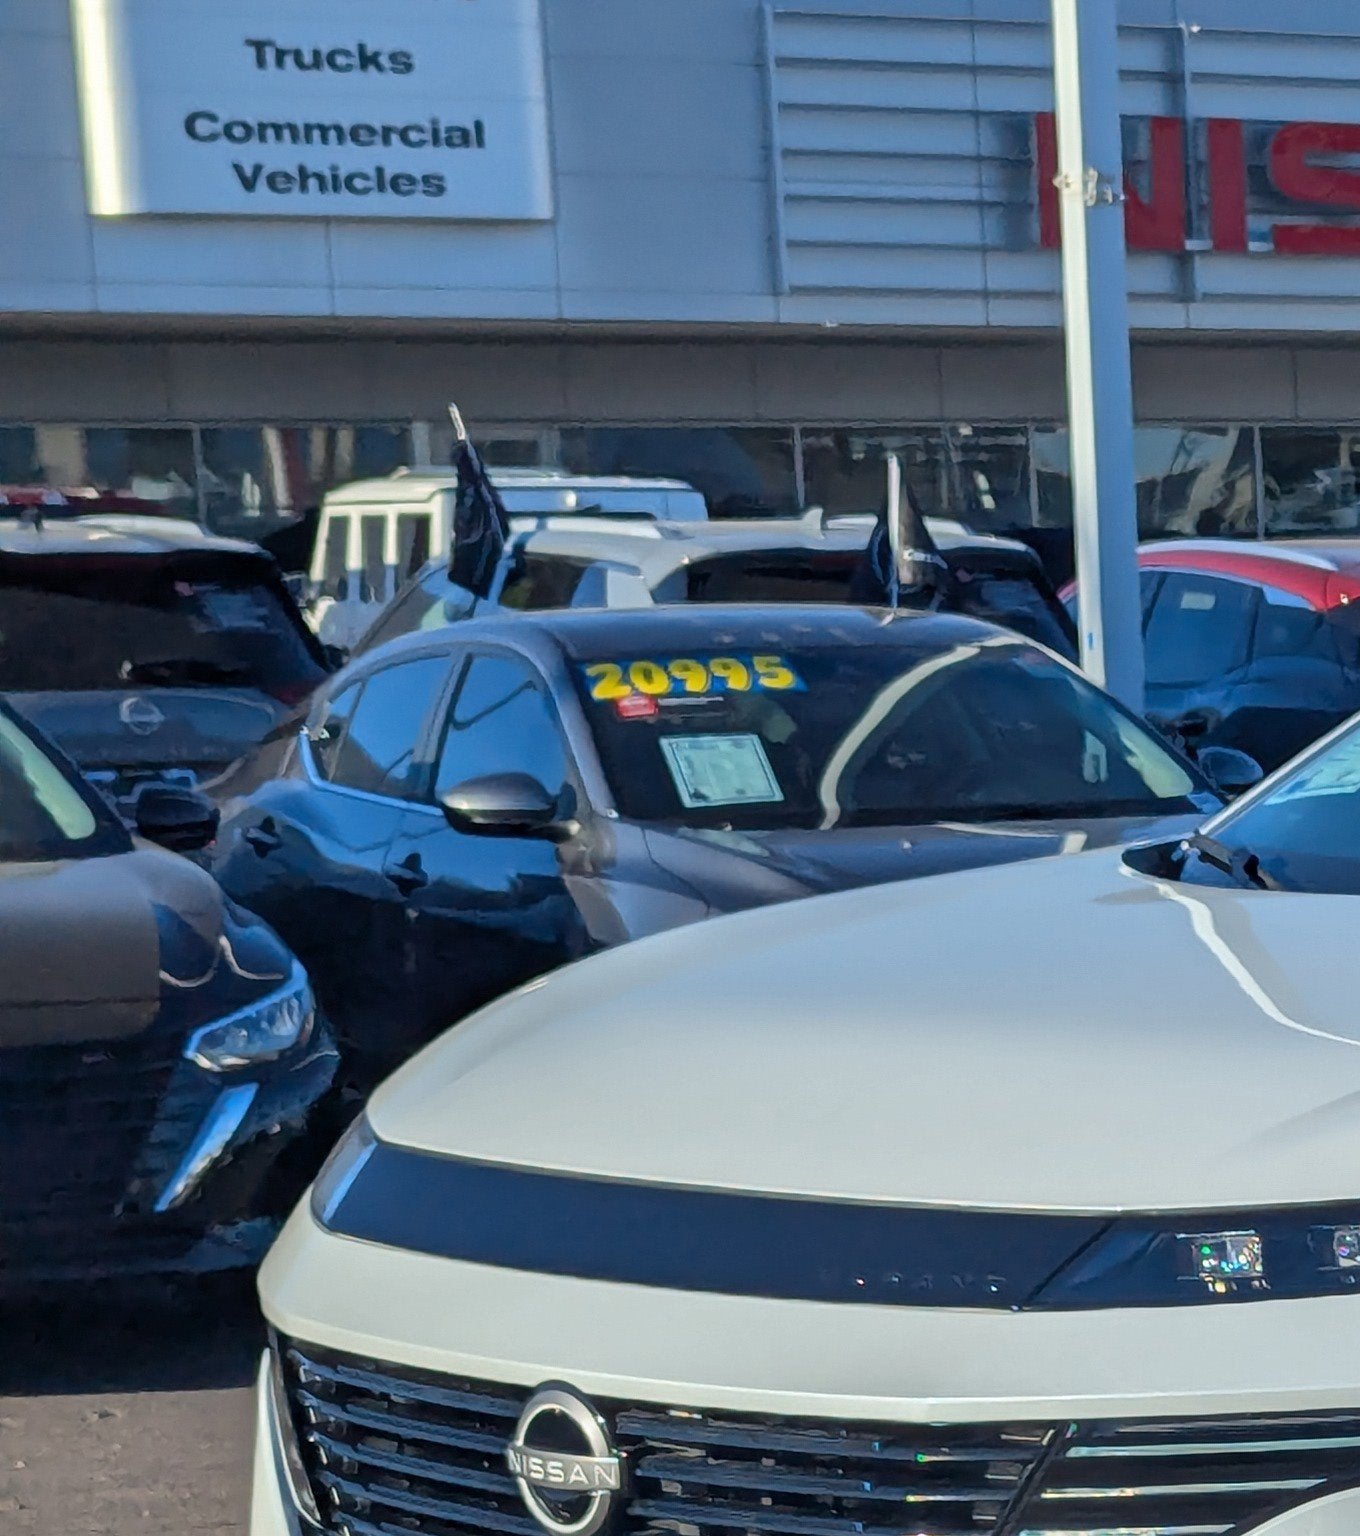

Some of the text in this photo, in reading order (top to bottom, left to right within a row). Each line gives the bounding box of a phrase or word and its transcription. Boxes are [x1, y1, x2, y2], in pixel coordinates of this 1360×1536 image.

[244, 38, 415, 75] Trucks
[184, 110, 486, 149] Commercial
[231, 161, 447, 198] Vehicles
[585, 656, 795, 700] 20995
[508, 1449, 616, 1487] NISSAN
